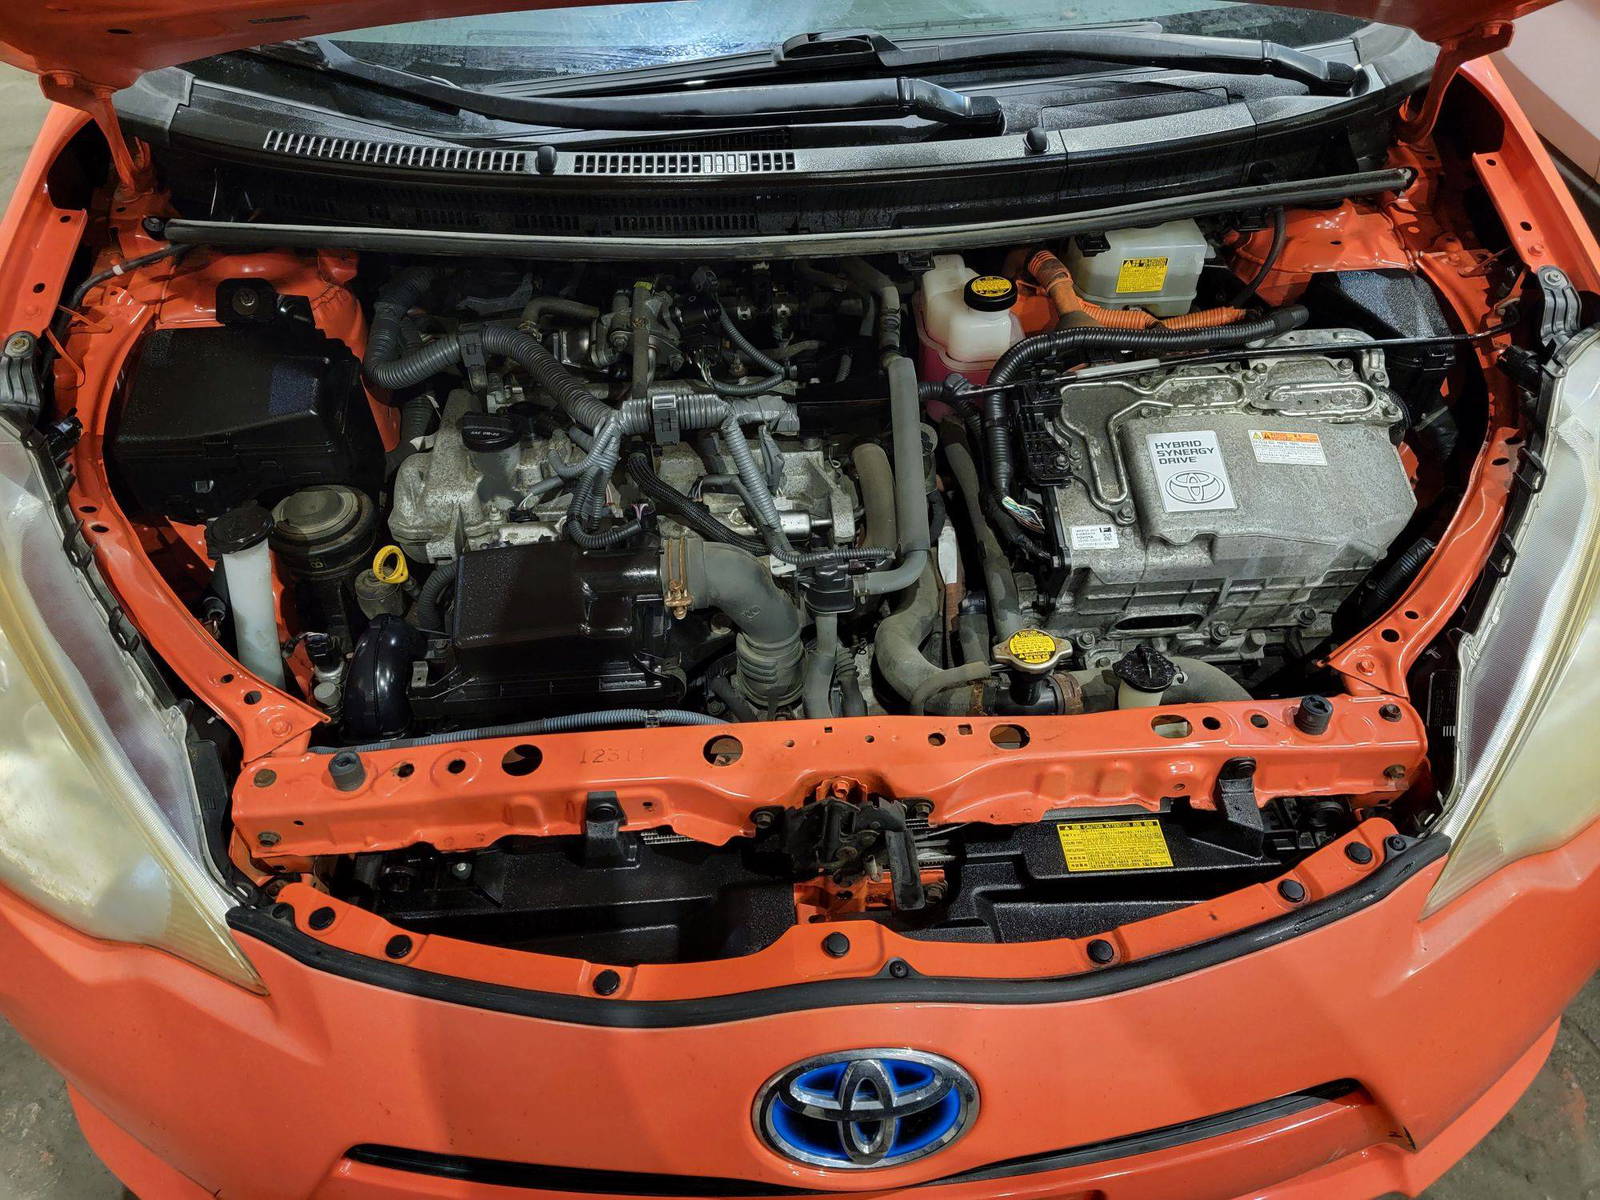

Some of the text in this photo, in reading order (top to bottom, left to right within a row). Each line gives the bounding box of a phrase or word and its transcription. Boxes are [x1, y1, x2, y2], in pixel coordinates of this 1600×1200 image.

[1155, 440, 1202, 449] HYBRID
[1157, 447, 1214, 457] SYNERGY
[1159, 456, 1198, 465] DRIVE
